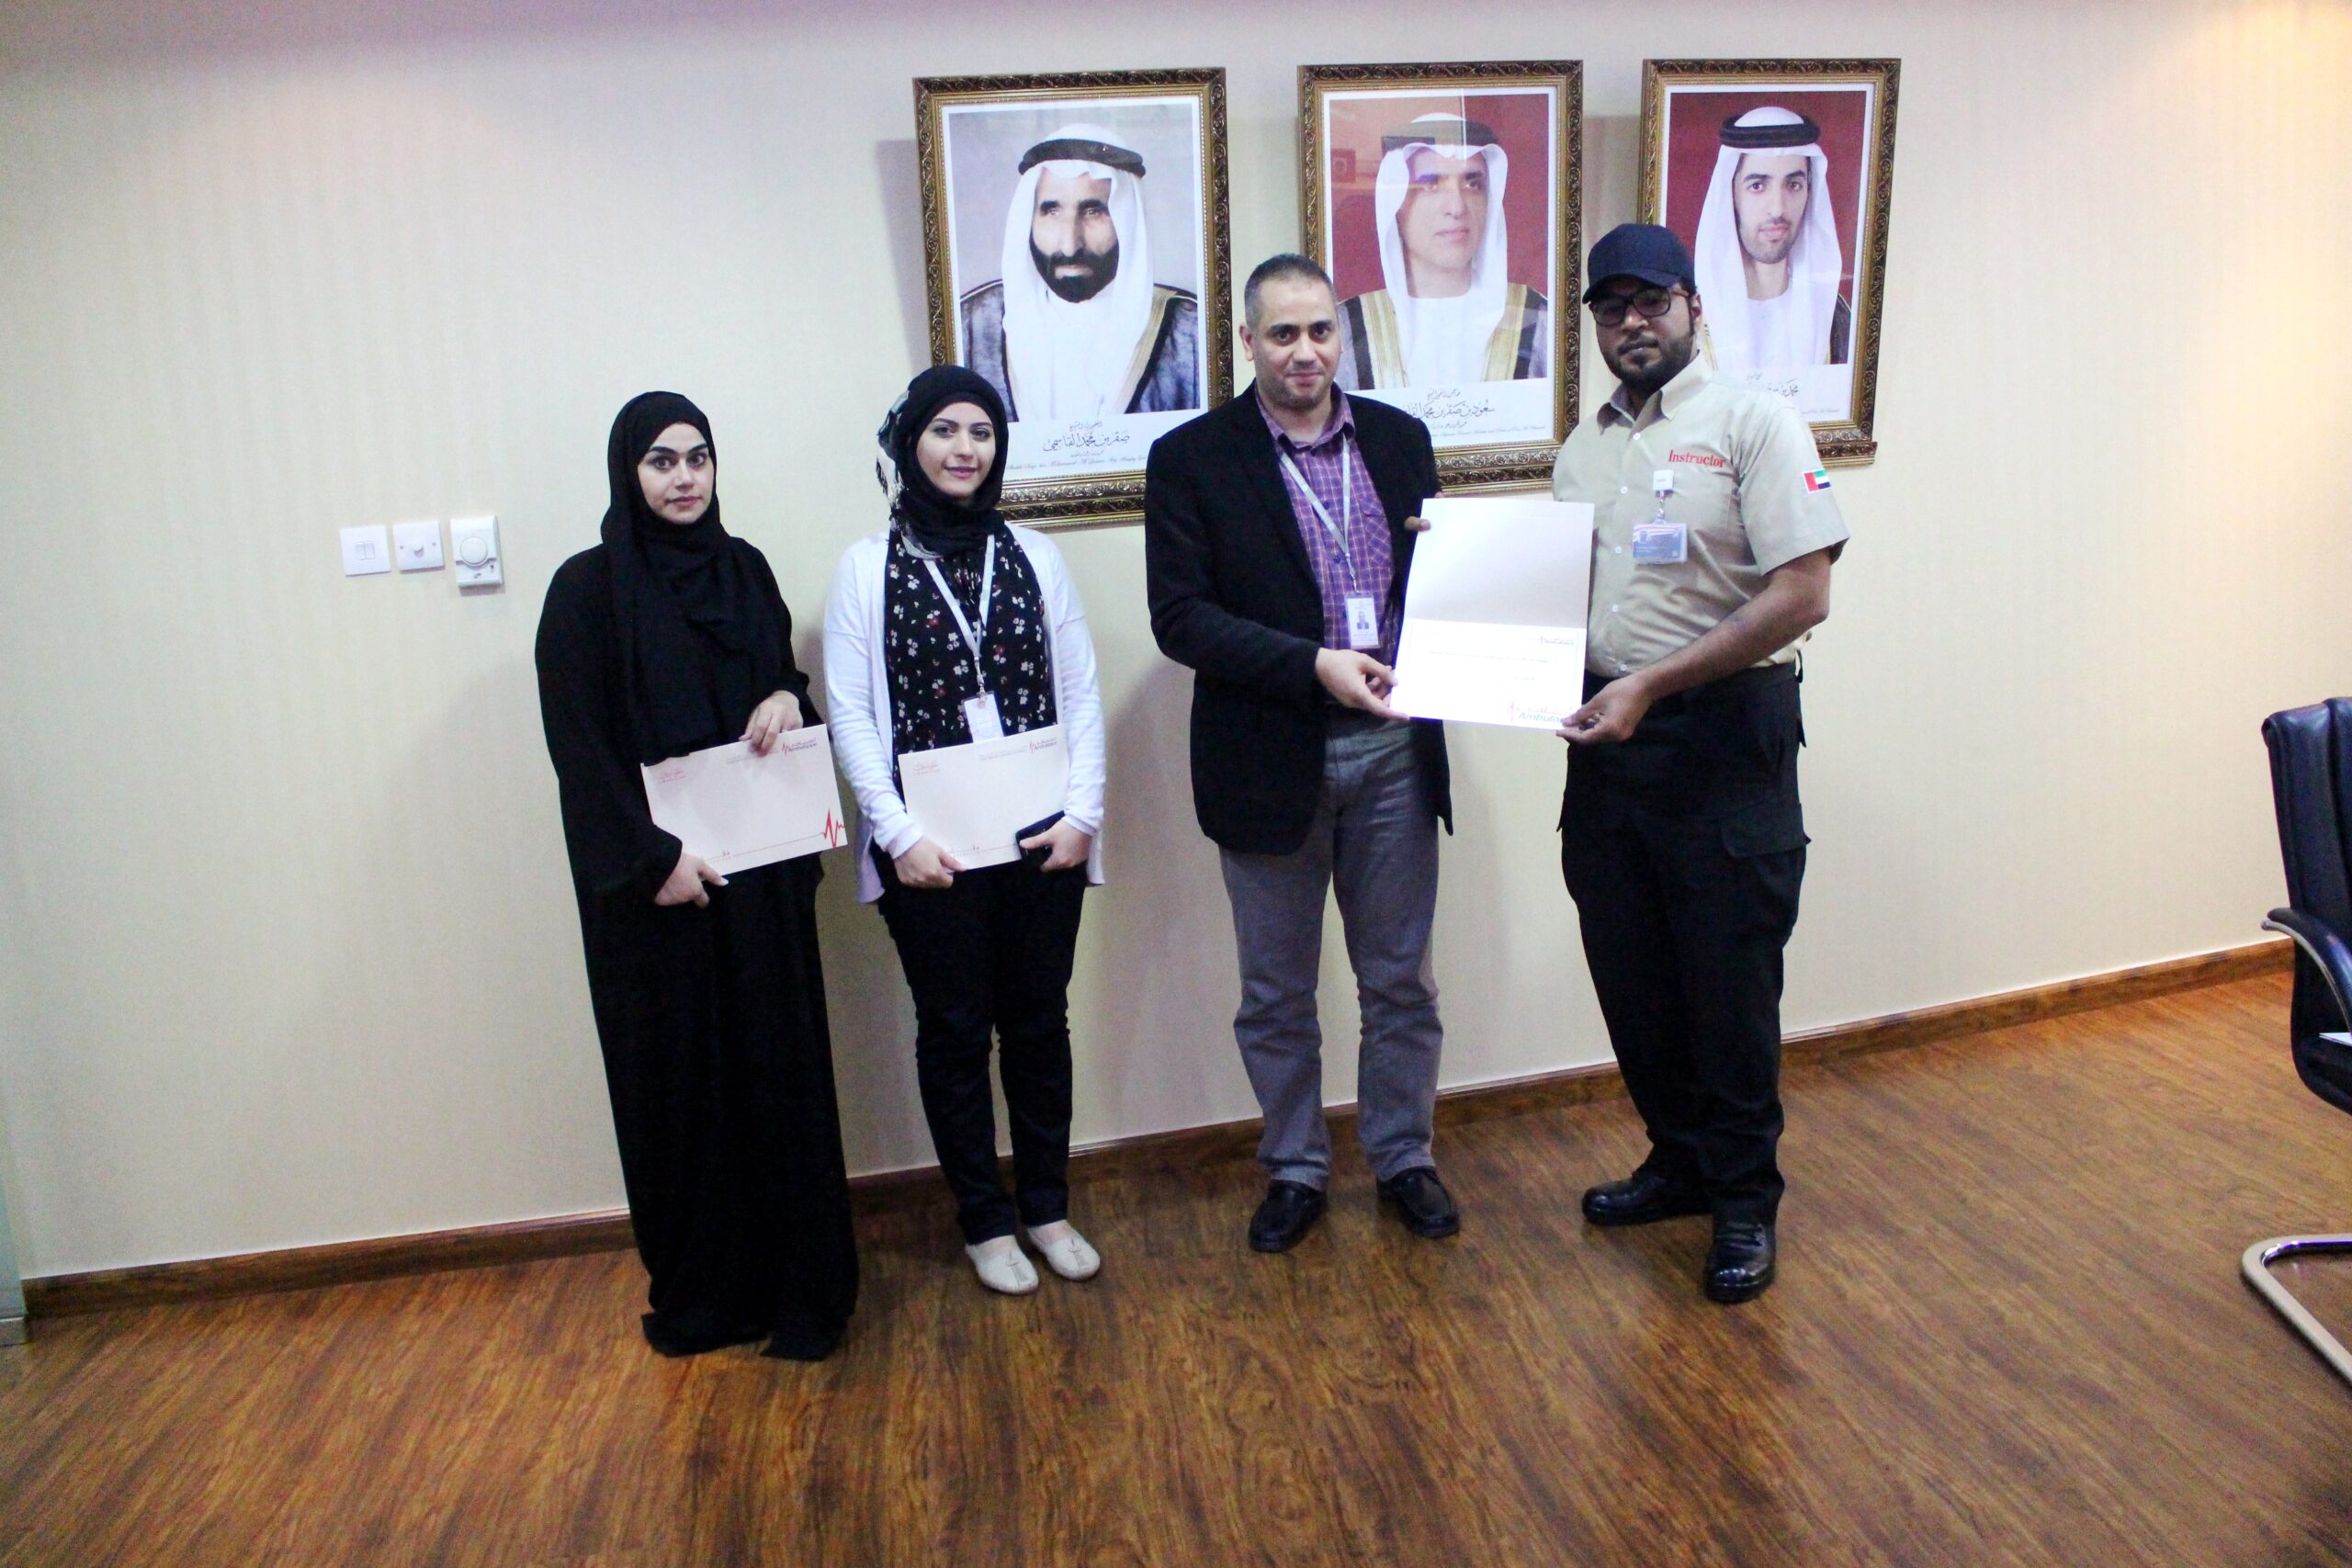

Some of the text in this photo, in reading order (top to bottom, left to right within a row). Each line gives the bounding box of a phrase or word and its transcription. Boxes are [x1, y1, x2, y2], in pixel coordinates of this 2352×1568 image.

[1107, 431, 1130, 446] صقر
[1668, 449, 1726, 468] Instructor
[1518, 712, 1562, 724] Ambula
